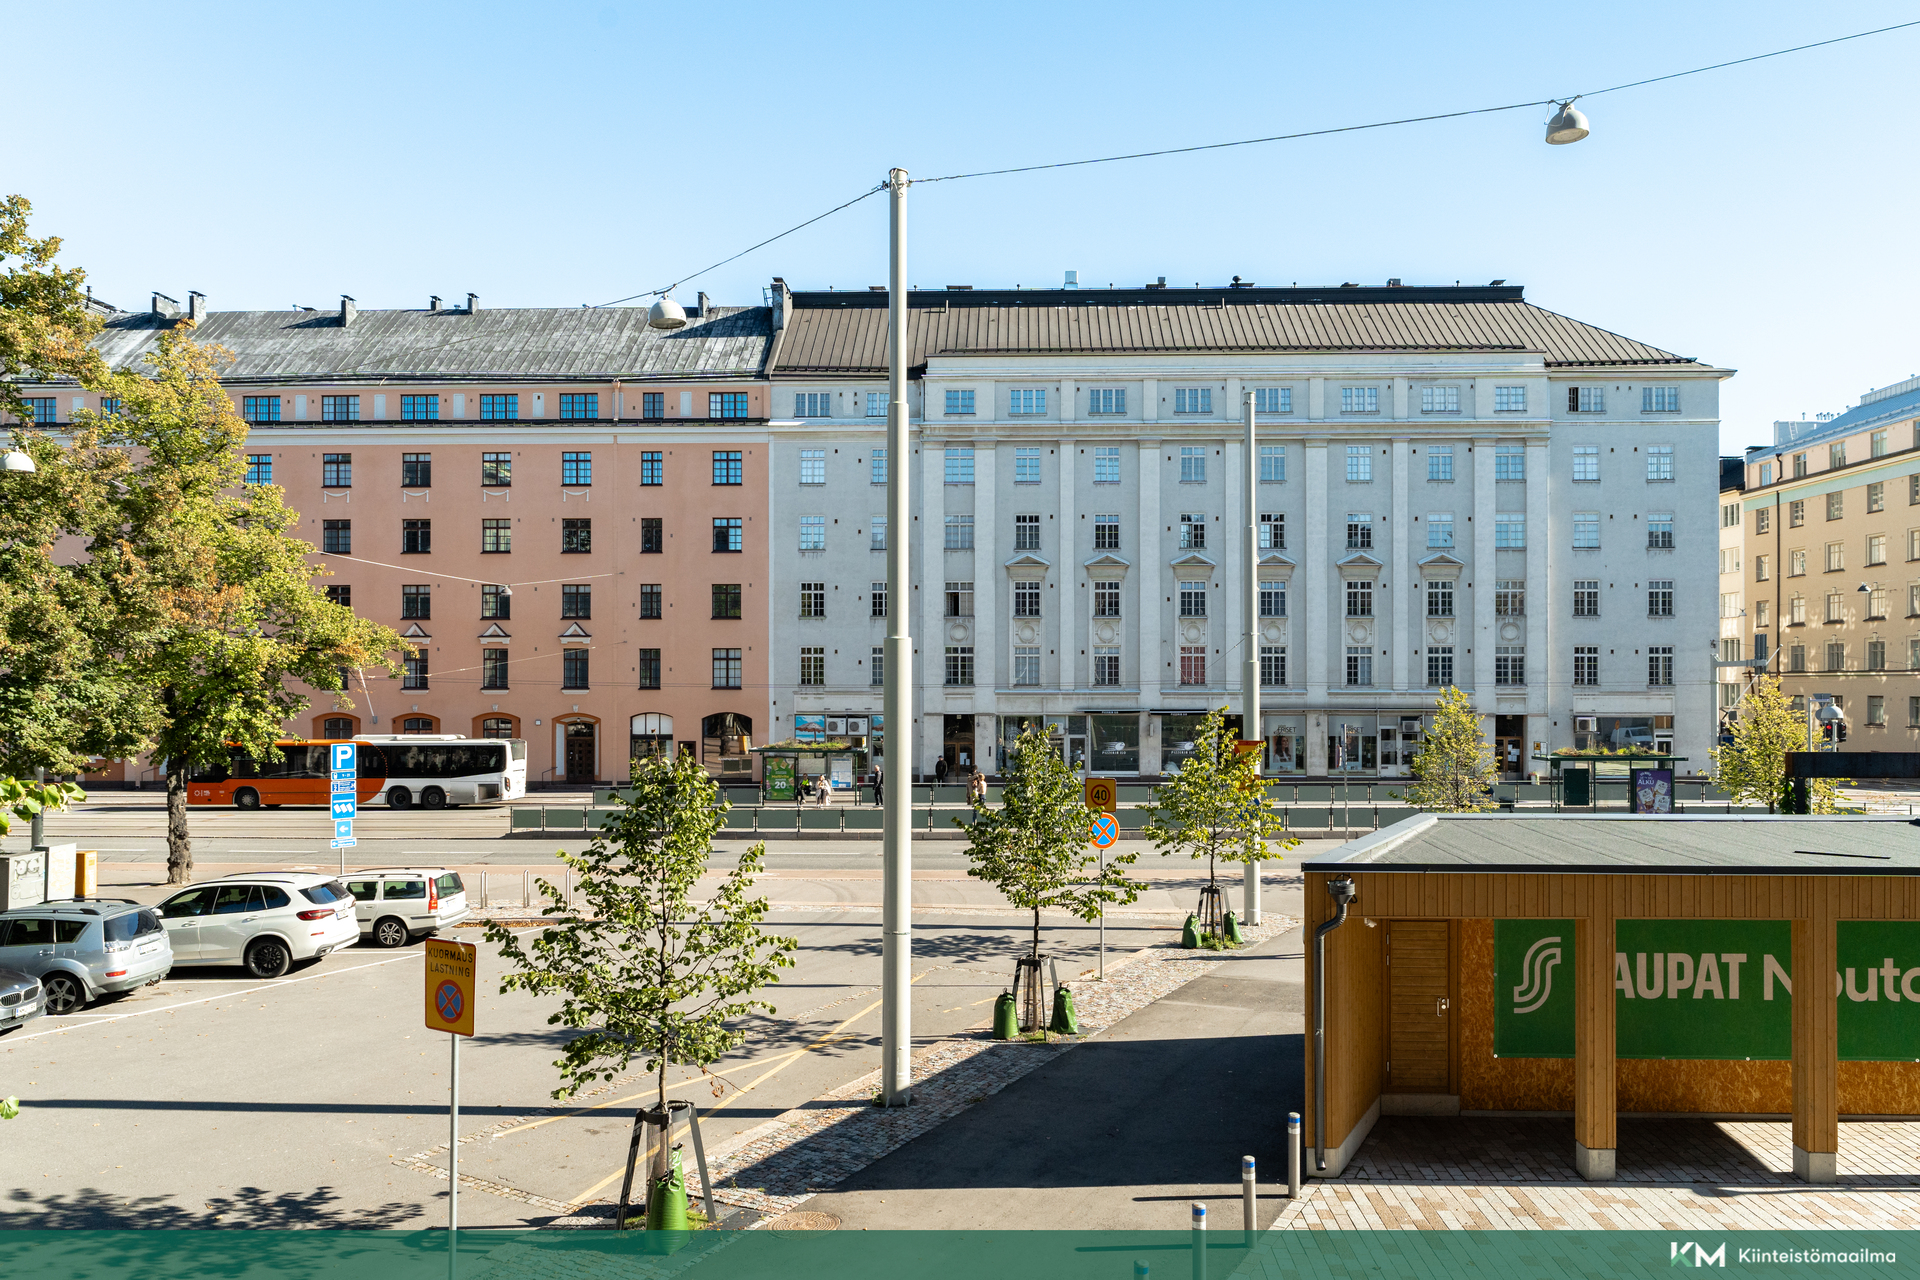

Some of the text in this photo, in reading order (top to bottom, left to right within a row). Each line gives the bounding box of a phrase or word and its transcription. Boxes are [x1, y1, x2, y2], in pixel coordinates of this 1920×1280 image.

[336, 746, 352, 768] P
[774, 781, 786, 789] 20
[1093, 789, 1107, 801] 40
[428, 947, 473, 963] KUORMAUS
[430, 962, 470, 978] LASTNING
[1616, 952, 1748, 1000] AUPAT
